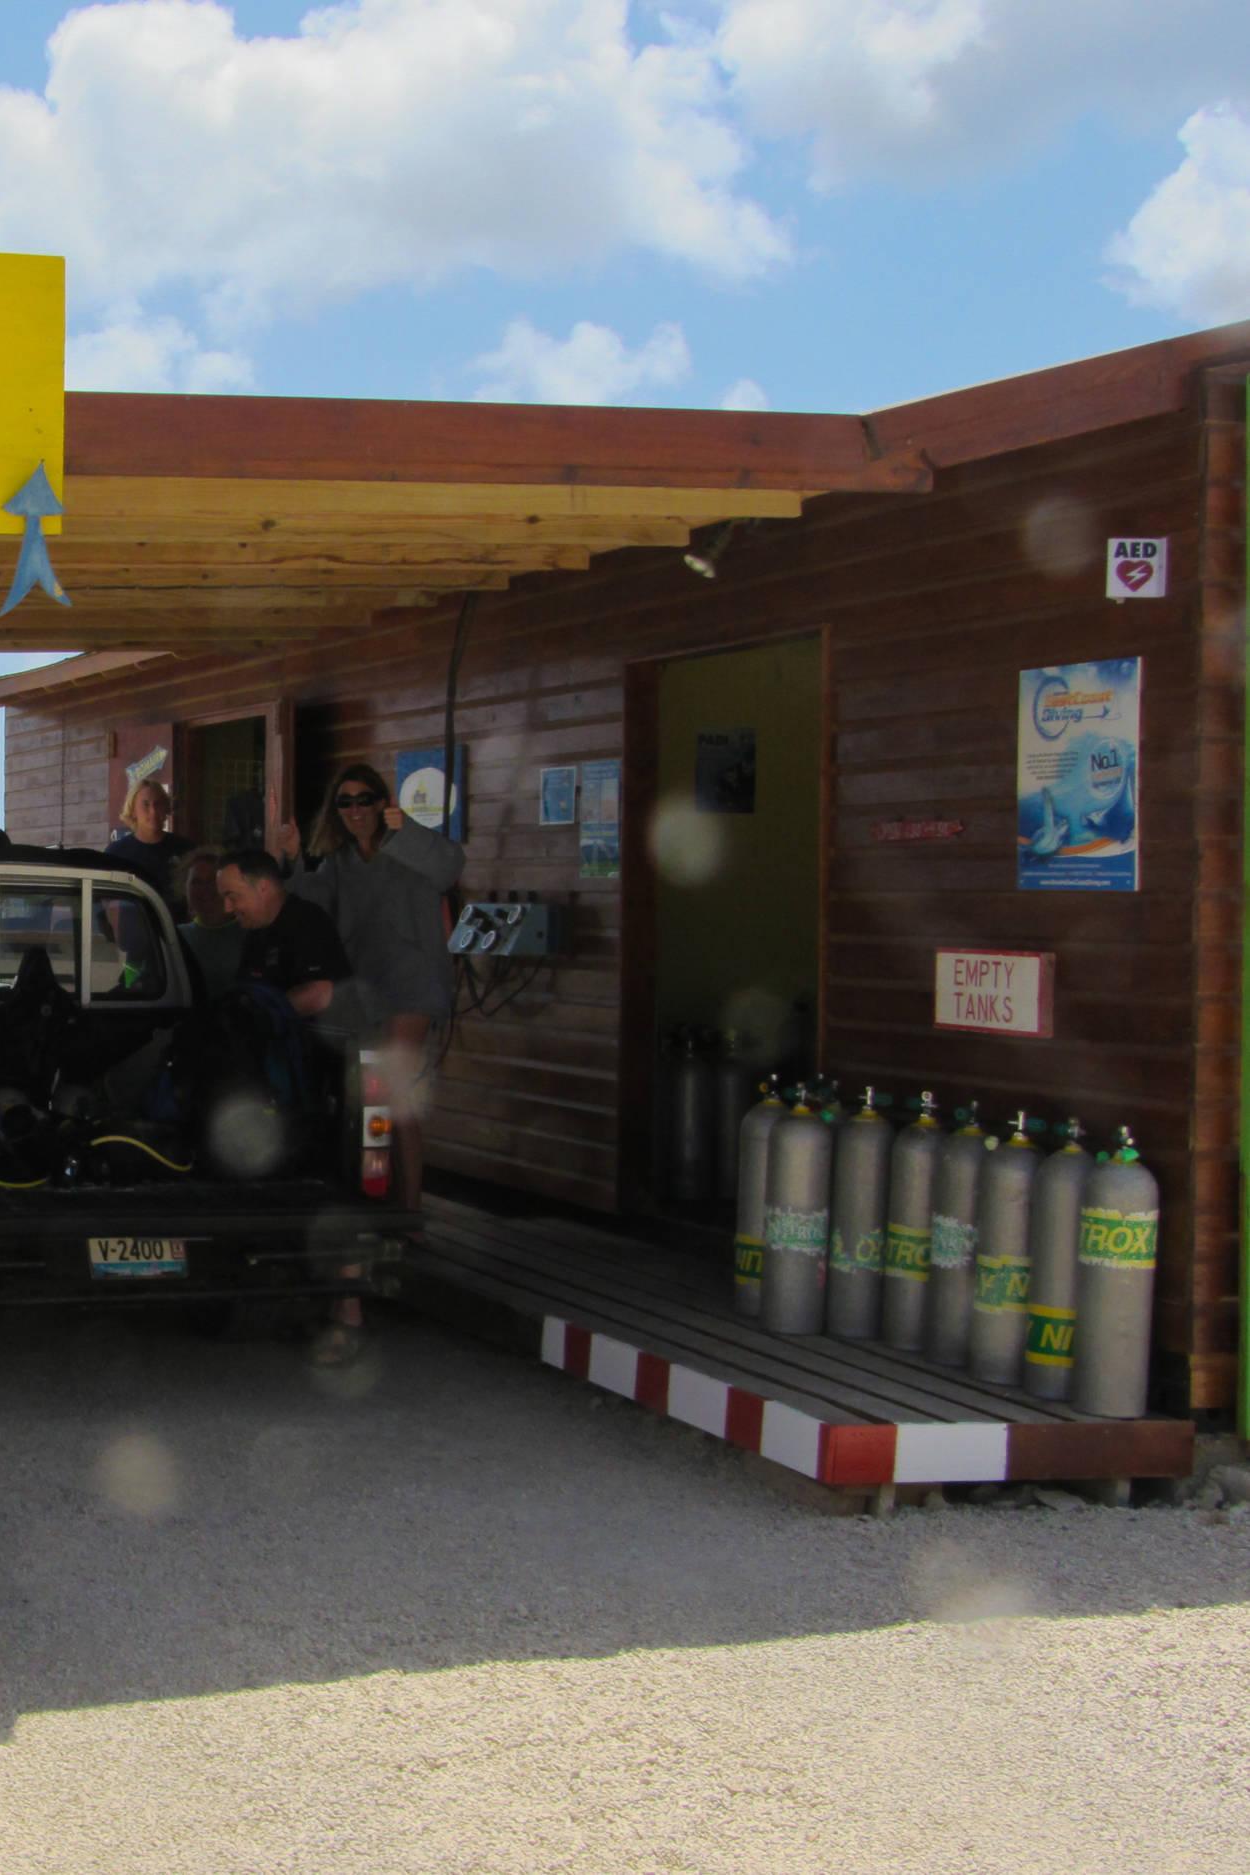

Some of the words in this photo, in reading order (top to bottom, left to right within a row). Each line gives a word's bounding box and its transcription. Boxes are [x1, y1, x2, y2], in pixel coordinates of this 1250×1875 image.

[1114, 542, 1157, 559] AED
[953, 958, 1015, 989] EMPTY
[953, 992, 1014, 1023] TANKS
[97, 1239, 164, 1261] V-2400
